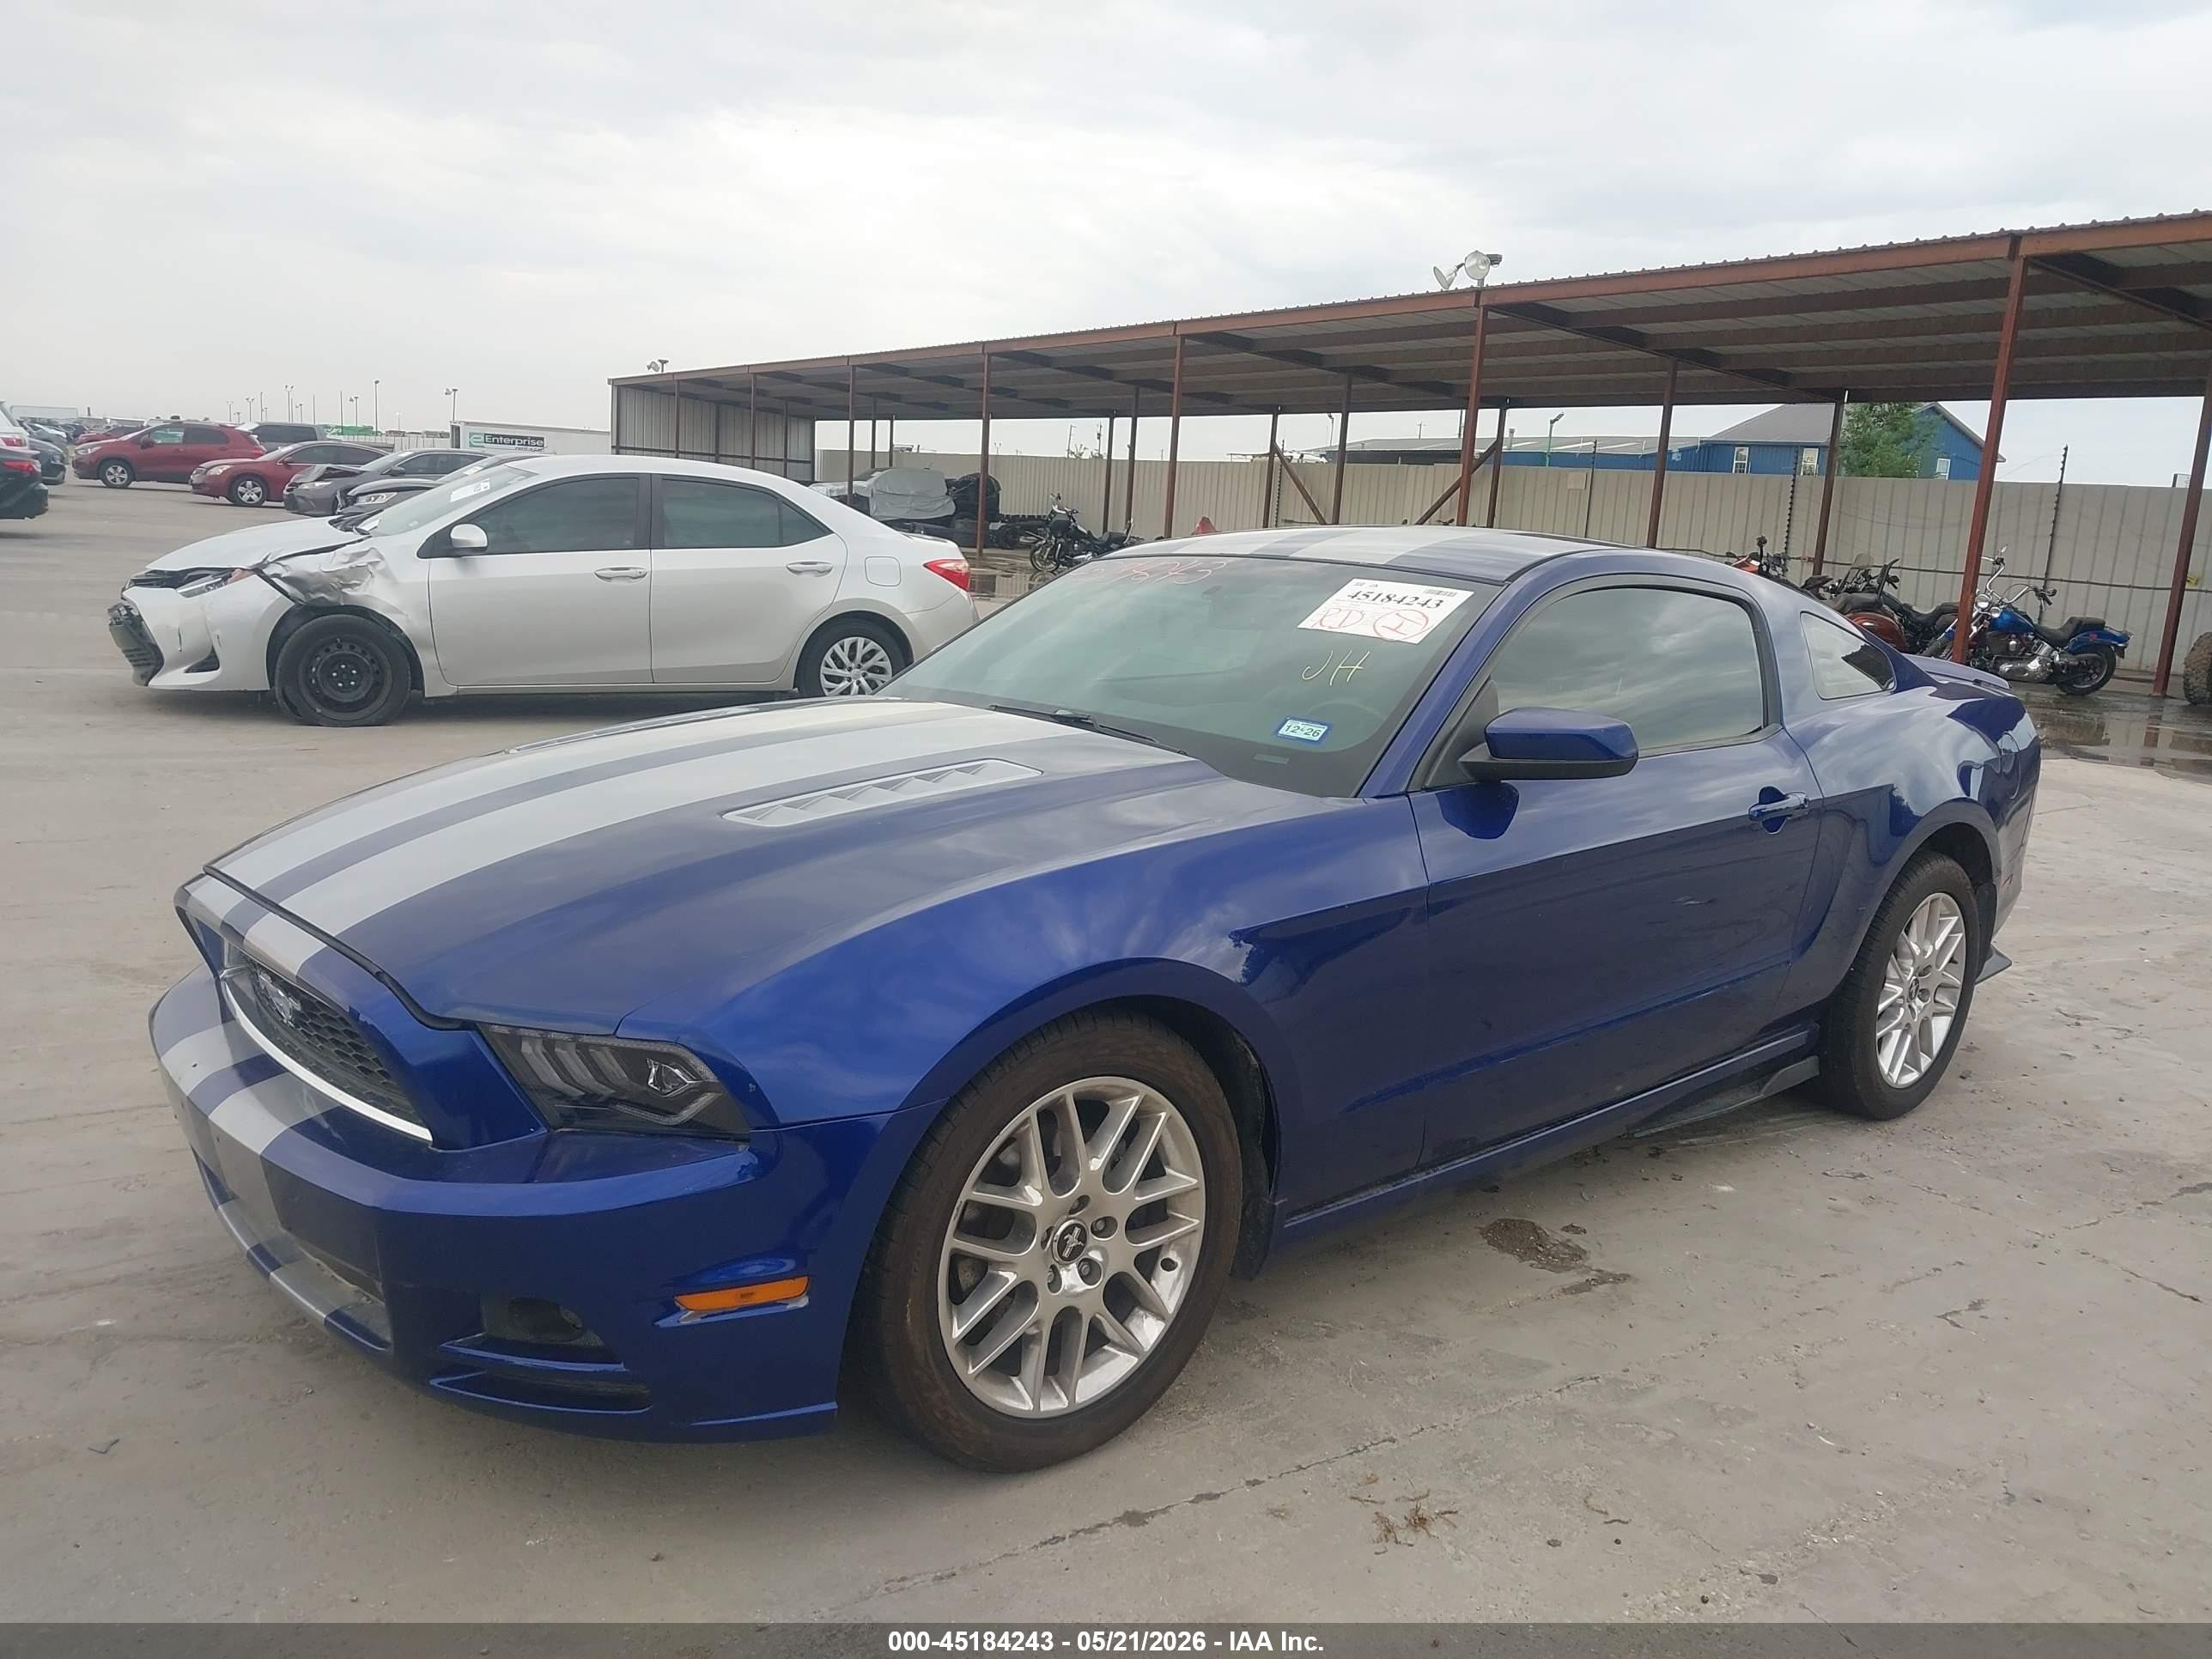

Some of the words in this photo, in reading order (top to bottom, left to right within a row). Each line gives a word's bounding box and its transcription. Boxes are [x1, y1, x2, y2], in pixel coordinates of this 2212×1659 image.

[485, 434, 544, 447] Enterprise
[1347, 590, 1443, 610] 45184243
[1301, 650, 1370, 686] JH
